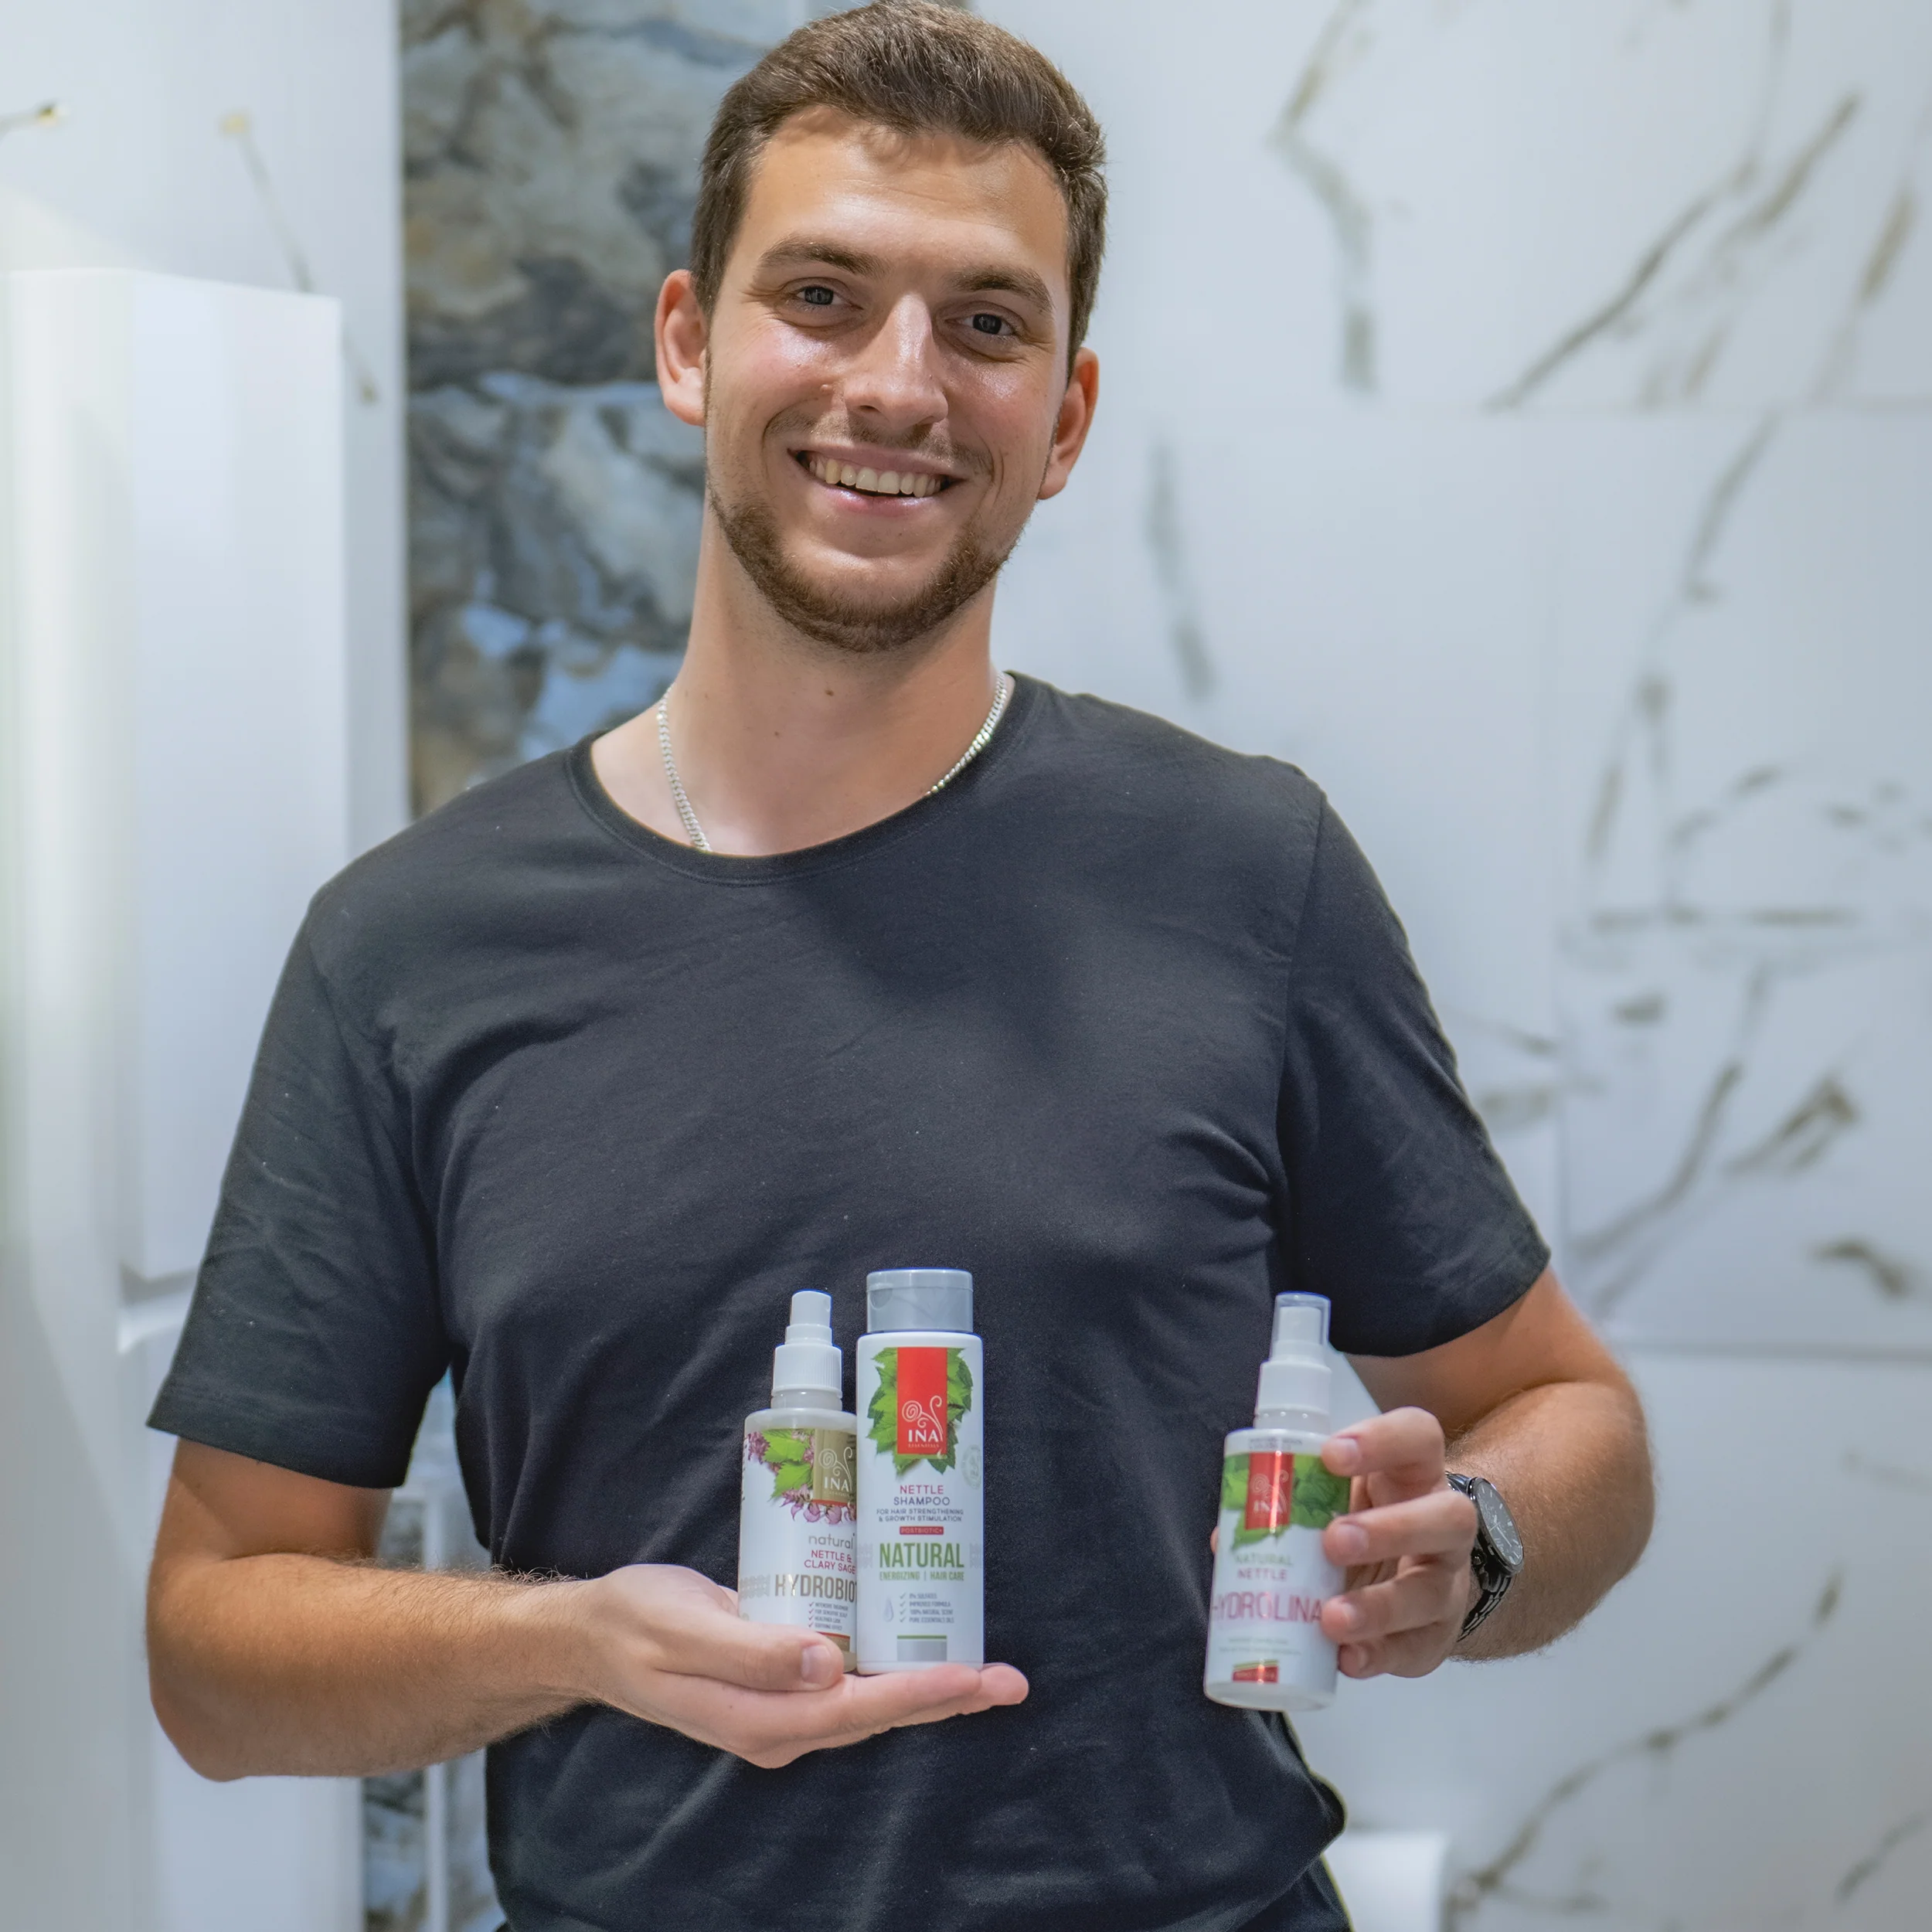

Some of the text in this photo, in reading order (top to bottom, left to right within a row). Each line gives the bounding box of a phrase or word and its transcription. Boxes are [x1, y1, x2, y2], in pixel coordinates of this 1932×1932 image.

[908, 1430, 939, 1442] INA
[824, 1477, 849, 1492] INA
[900, 1485, 944, 1495] NETTLE
[893, 1497, 951, 1506] SHAMPOO
[808, 1533, 853, 1549] natural
[811, 1549, 852, 1563] NETTLE &
[879, 1543, 964, 1568] NATURAL
[1235, 1552, 1293, 1566] NATURAL
[804, 1560, 856, 1574] CLARY SAGE
[1238, 1568, 1288, 1580] NETTLE
[879, 1571, 964, 1581] ENERGIZING HAIR CARE
[775, 1574, 857, 1603] HYDROBIO
